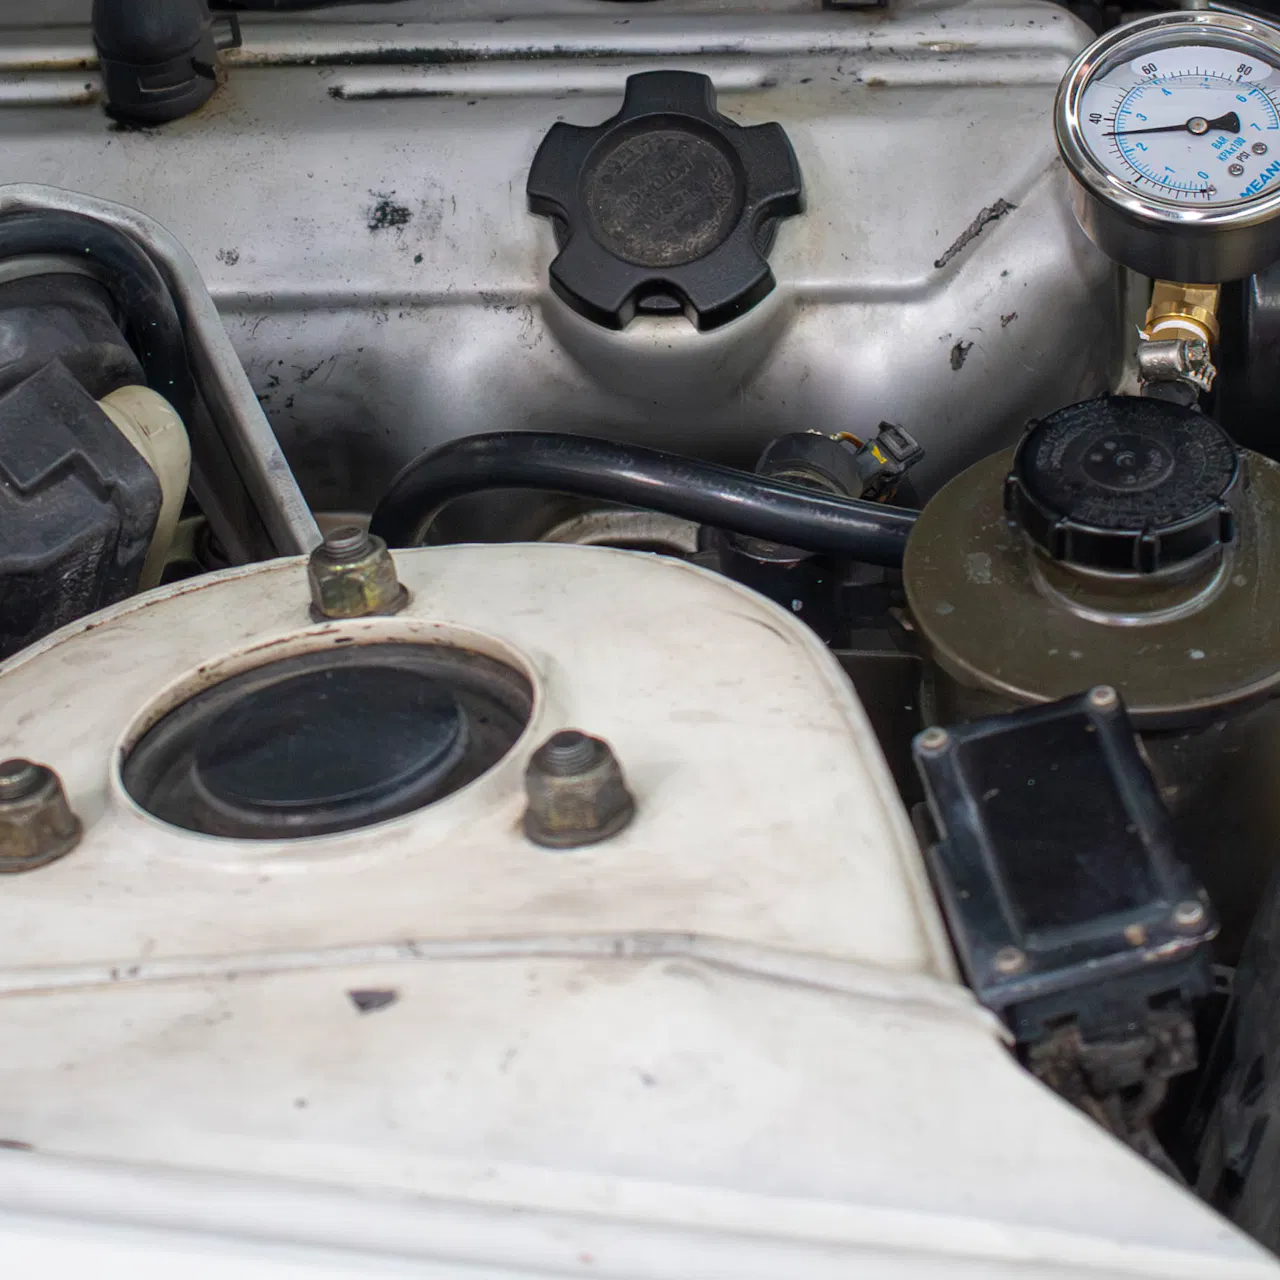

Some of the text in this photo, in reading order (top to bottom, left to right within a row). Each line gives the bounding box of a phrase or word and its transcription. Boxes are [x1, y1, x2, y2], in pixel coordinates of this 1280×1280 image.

[1141, 62, 1158, 76] 60
[1236, 63, 1253, 76] 80
[1161, 87, 1173, 97] 4
[1235, 94, 1247, 104] 6
[1089, 113, 1102, 125] 40
[1136, 113, 1147, 121] 3
[1250, 123, 1261, 132] 7
[1136, 142, 1148, 152] 2
[1211, 136, 1228, 150] BAR
[1236, 150, 1251, 163] PSI
[1164, 166, 1176, 175] 1
[1197, 171, 1209, 180] 0
